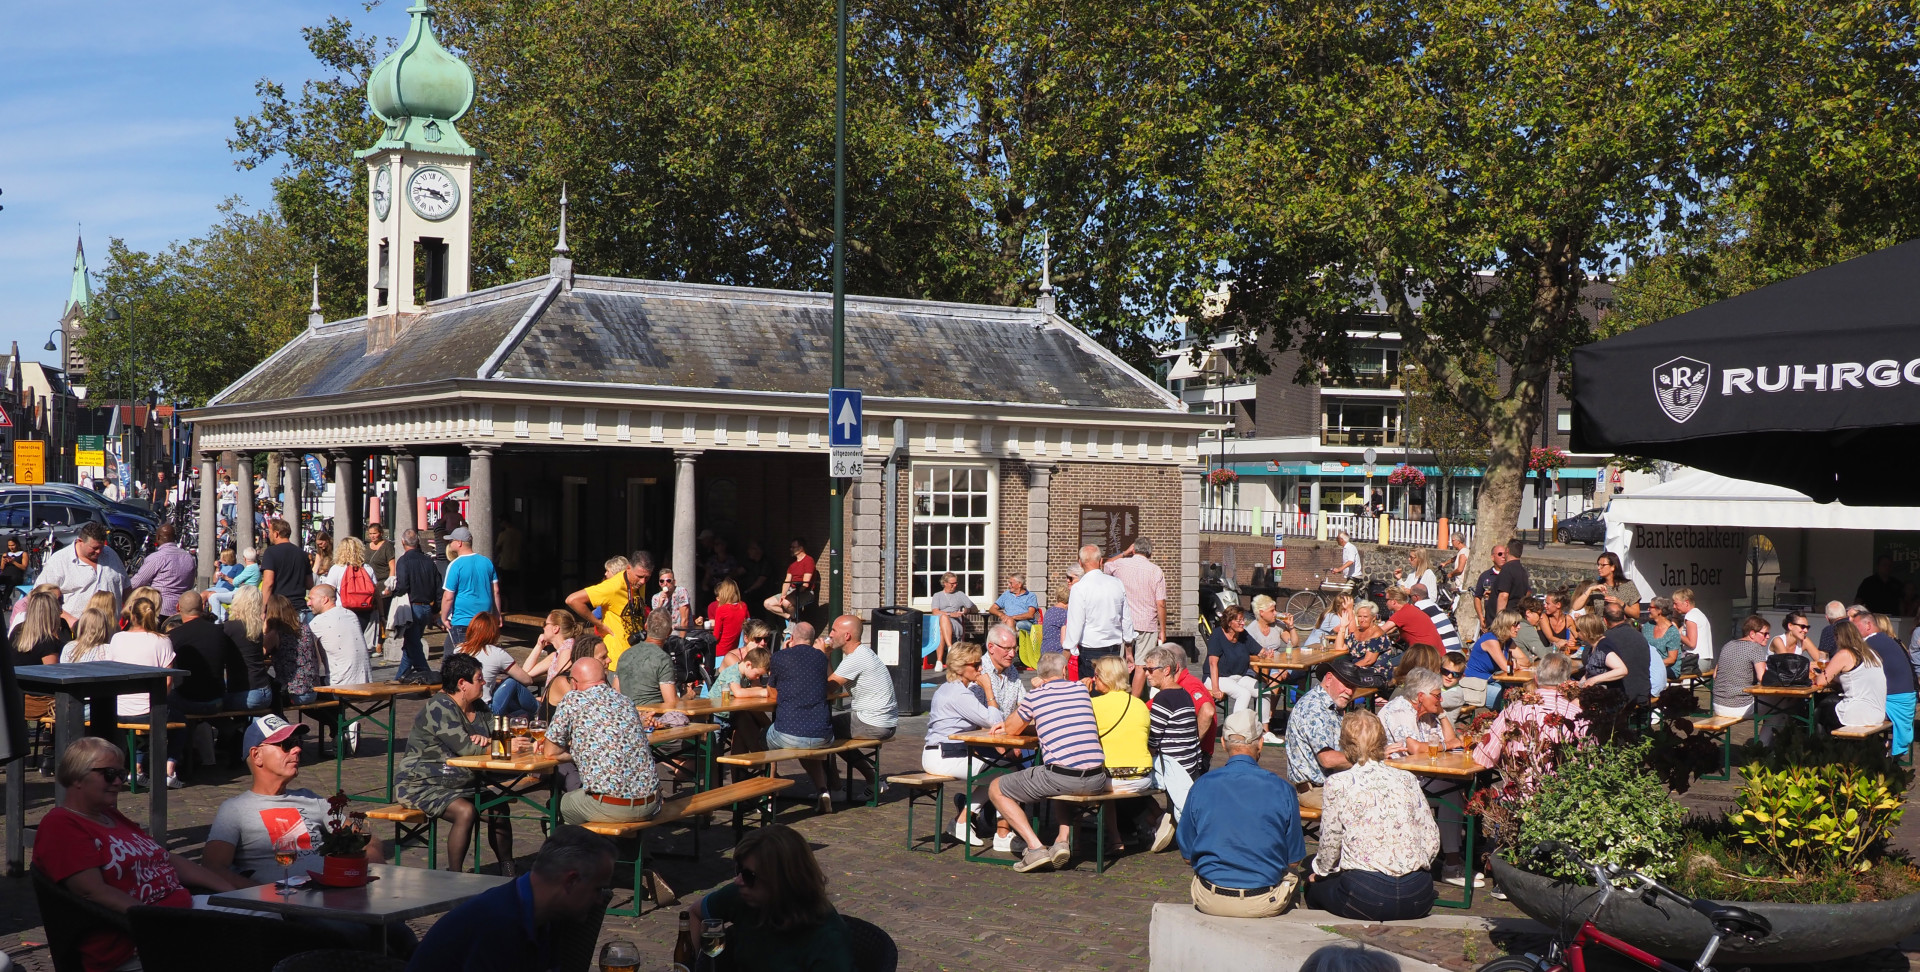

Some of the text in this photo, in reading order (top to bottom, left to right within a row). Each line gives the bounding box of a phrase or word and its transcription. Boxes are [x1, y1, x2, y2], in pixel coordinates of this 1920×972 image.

[833, 450, 863, 458] uitgezonderd
[1636, 524, 1745, 554] Banketbakkerij
[1275, 553, 1282, 565] 6
[1892, 547, 1920, 562] Iris
[1661, 562, 1723, 586] Jan Boer
